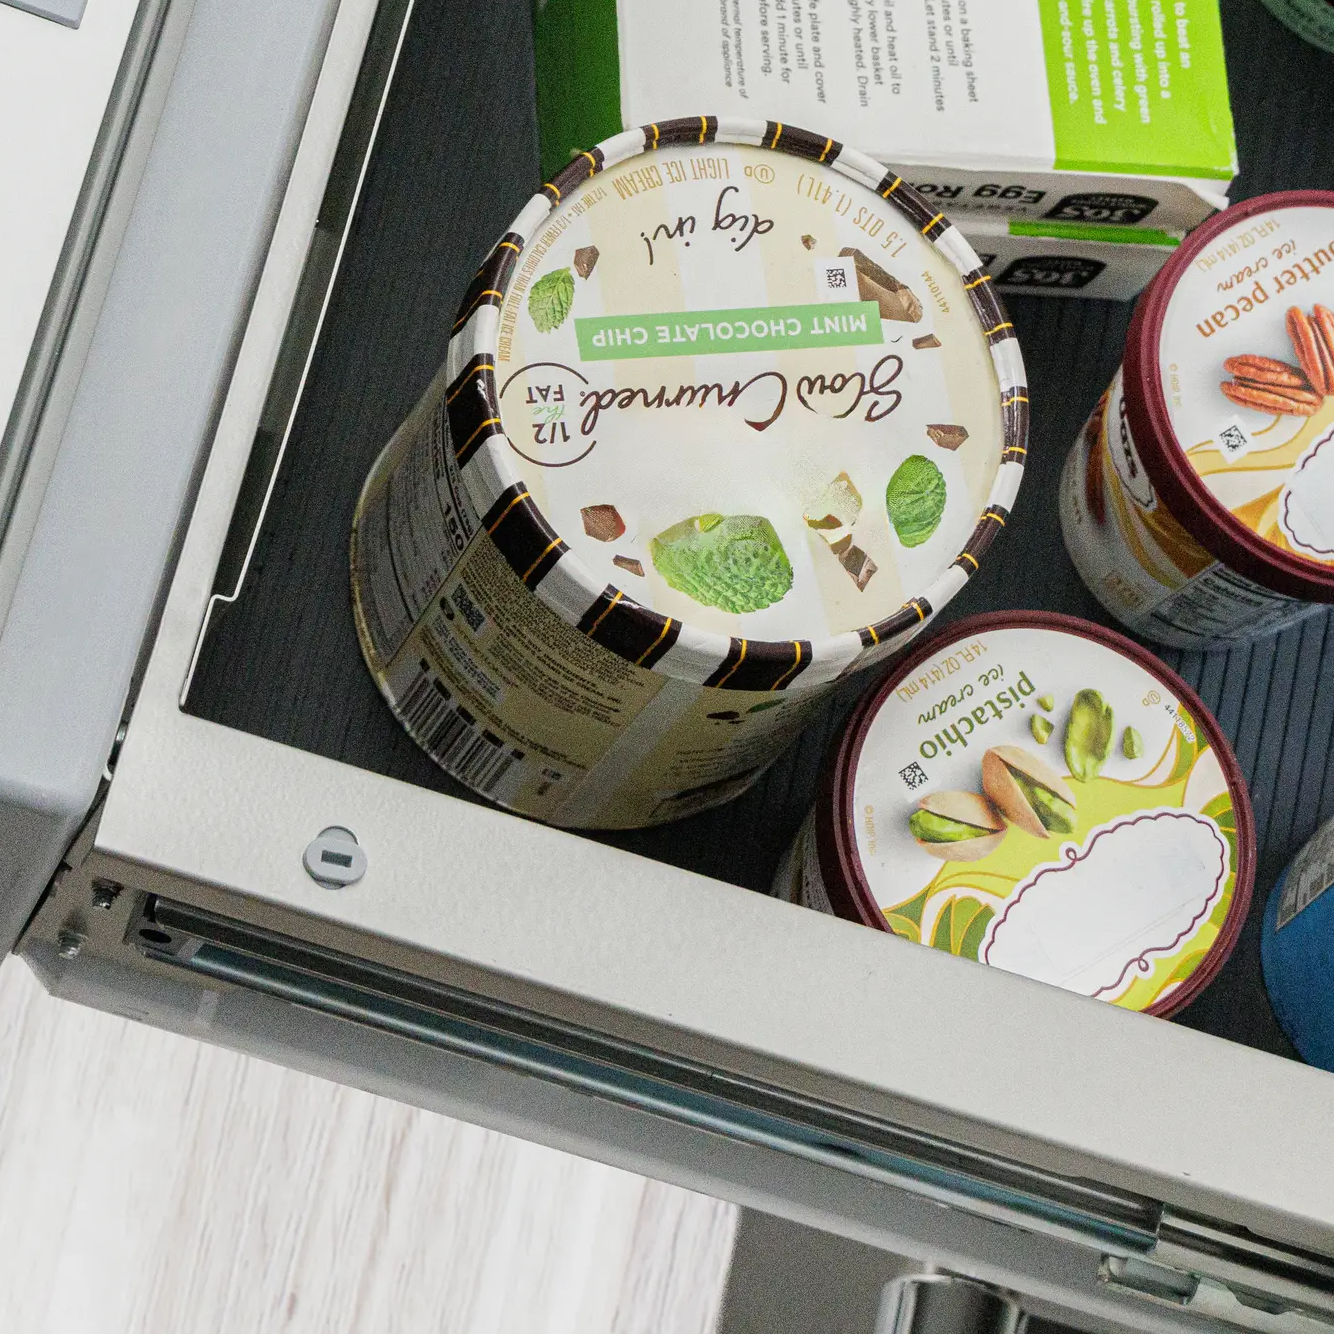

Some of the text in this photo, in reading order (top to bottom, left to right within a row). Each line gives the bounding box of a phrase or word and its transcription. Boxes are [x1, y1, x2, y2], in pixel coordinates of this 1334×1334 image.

[957, 0, 968, 16] on
[958, 17, 969, 26] a
[925, 18, 941, 53] stand
[942, 23, 954, 38] or
[759, 29, 773, 79] serving.
[928, 54, 942, 64] 2
[944, 39, 960, 67] until
[959, 27, 974, 69] baking
[1132, 51, 1149, 83] with
[931, 64, 946, 113] minutes
[964, 70, 979, 103] sheet
[1133, 83, 1152, 125] green
[612, 157, 729, 200] LIGHT ICE CREAM
[972, 183, 1046, 204] Egg
[640, 185, 774, 266] dig in!
[797, 173, 908, 258] 1.5 QTS (1.41L)
[540, 222, 562, 247] FEWER
[521, 243, 547, 276] CALORIES
[1216, 239, 1296, 293] ice cream
[513, 272, 531, 293] THAN
[922, 270, 950, 313] 44110144
[1195, 281, 1270, 339] pecan
[499, 321, 513, 336] ICE
[592, 313, 867, 347] MINT CHOCOLATE CHIP
[497, 334, 511, 362] CREAM
[525, 384, 565, 404] FAT
[532, 404, 566, 425] the
[532, 421, 571, 444] 1/2
[956, 647, 974, 663] FL
[972, 639, 988, 657] 14
[918, 663, 946, 690] (414
[941, 656, 961, 675] OZ
[917, 664, 1004, 725] ice cream
[918, 670, 1037, 761] pistachio
